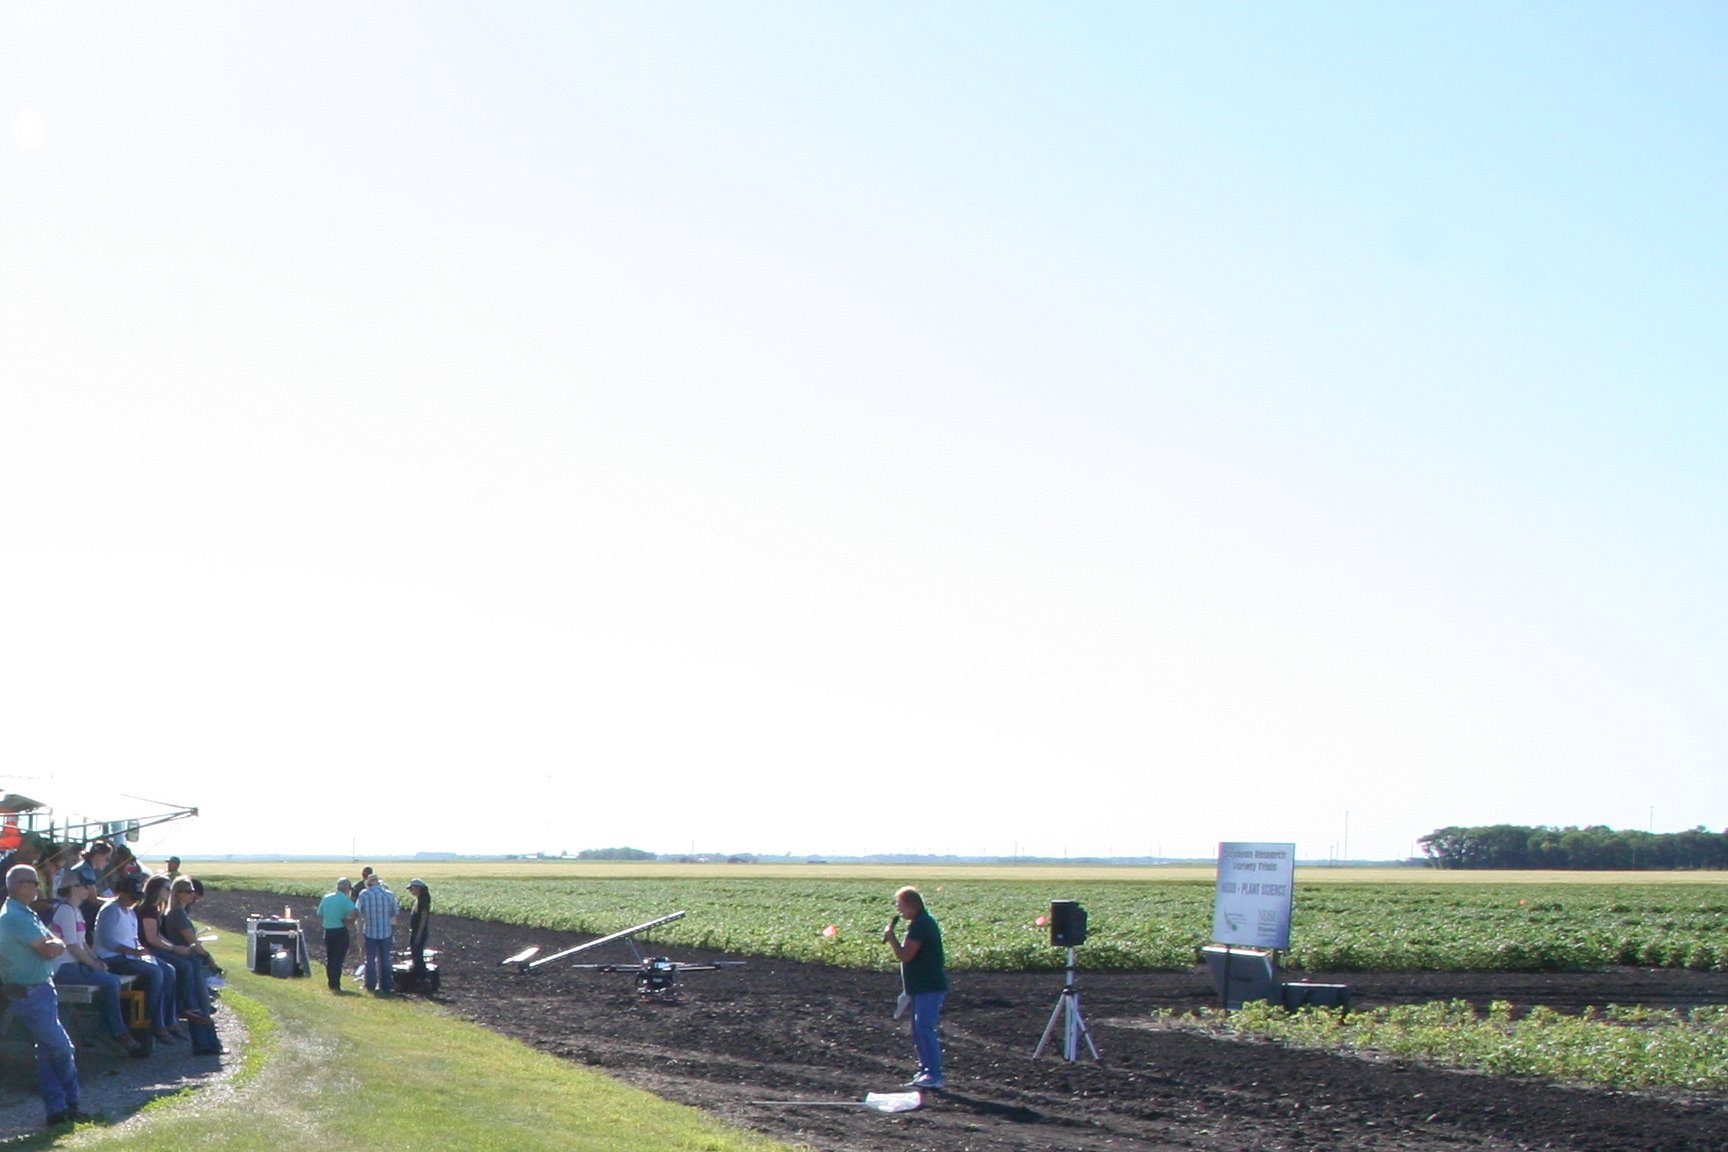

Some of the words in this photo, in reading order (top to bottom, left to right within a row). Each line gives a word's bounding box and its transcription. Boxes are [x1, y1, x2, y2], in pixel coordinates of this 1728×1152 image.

[1255, 850, 1286, 859] Research
[1232, 863, 1256, 872] Variety
[1258, 863, 1277, 872] Trials
[1241, 883, 1260, 895] PLANT
[1261, 884, 1287, 896] SCIENCE
